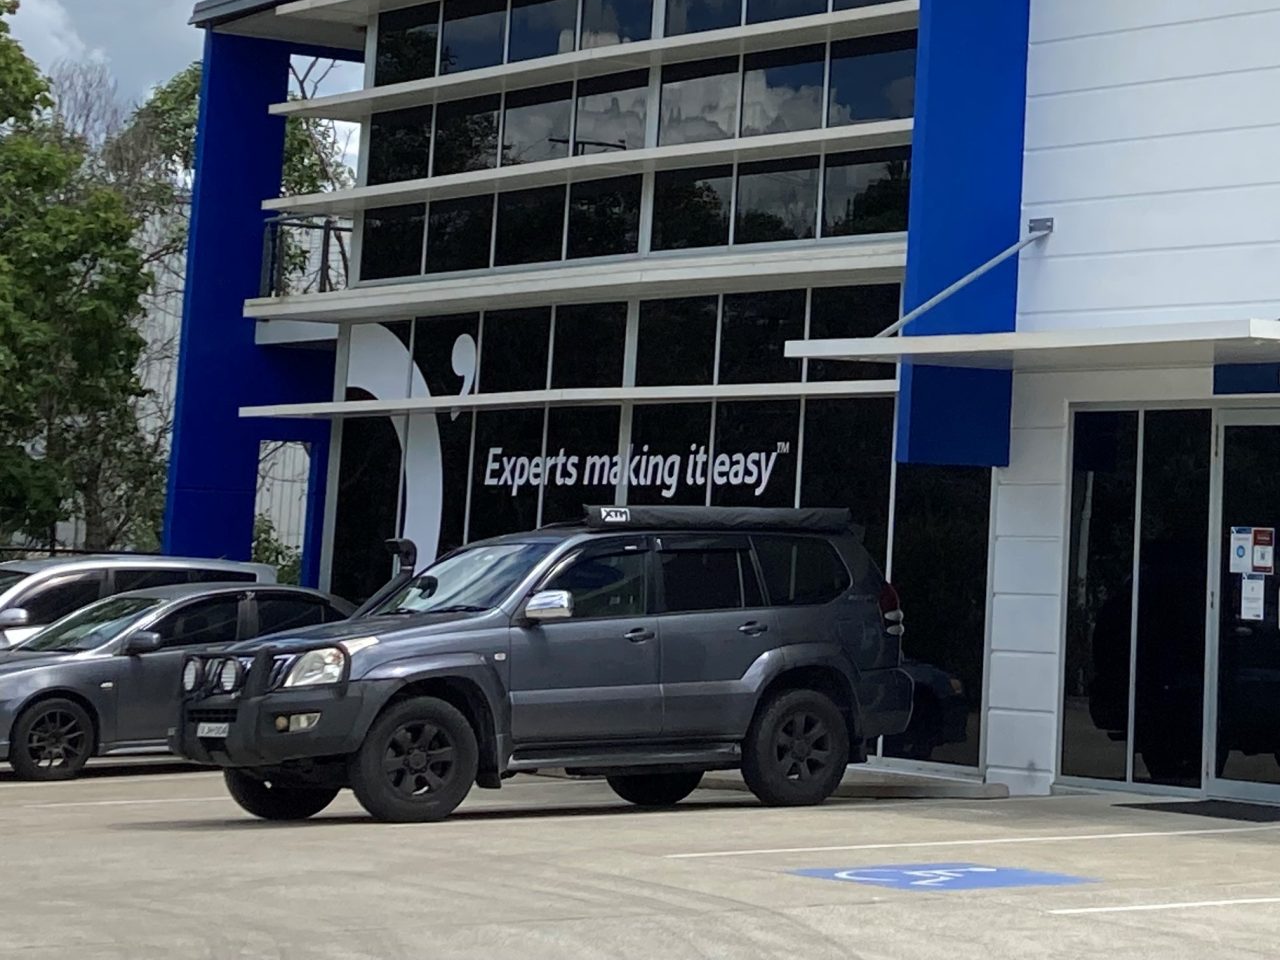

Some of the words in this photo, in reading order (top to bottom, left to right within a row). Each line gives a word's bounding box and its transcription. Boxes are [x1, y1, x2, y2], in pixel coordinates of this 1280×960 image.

[484, 446, 578, 496] Experts
[582, 443, 681, 498] making
[686, 443, 708, 486] it
